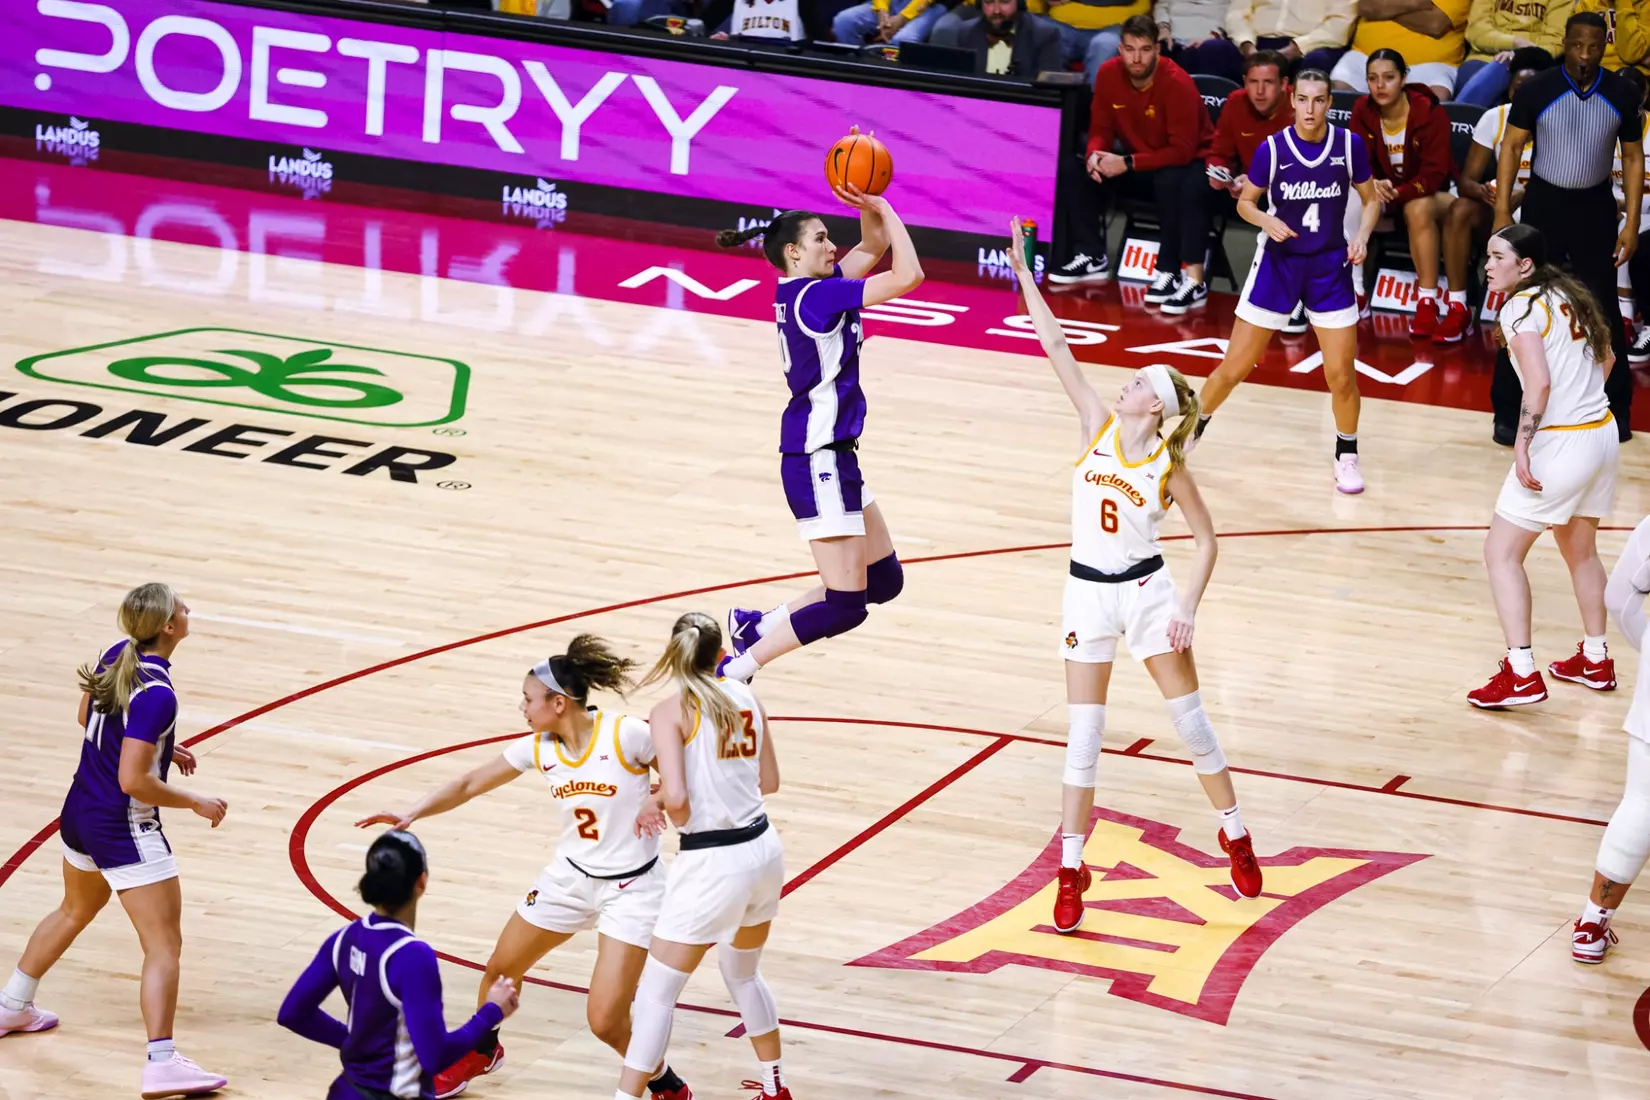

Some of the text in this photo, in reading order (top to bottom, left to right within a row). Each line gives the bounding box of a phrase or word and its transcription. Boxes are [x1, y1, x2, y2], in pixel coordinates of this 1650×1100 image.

[36, 124, 100, 148] LANDUS
[269, 155, 333, 179] LANDUS
[502, 185, 567, 209] LANDUS
[1280, 181, 1342, 200] Wildcats
[1302, 203, 1320, 232] 4
[979, 247, 1045, 272] LANS
[1560, 303, 1587, 342] 2
[0, 391, 457, 484] ONEER
[1085, 469, 1147, 508] Cyclones
[1101, 498, 1118, 534] 6
[551, 779, 617, 799] Cyclones
[574, 807, 599, 841] 2
